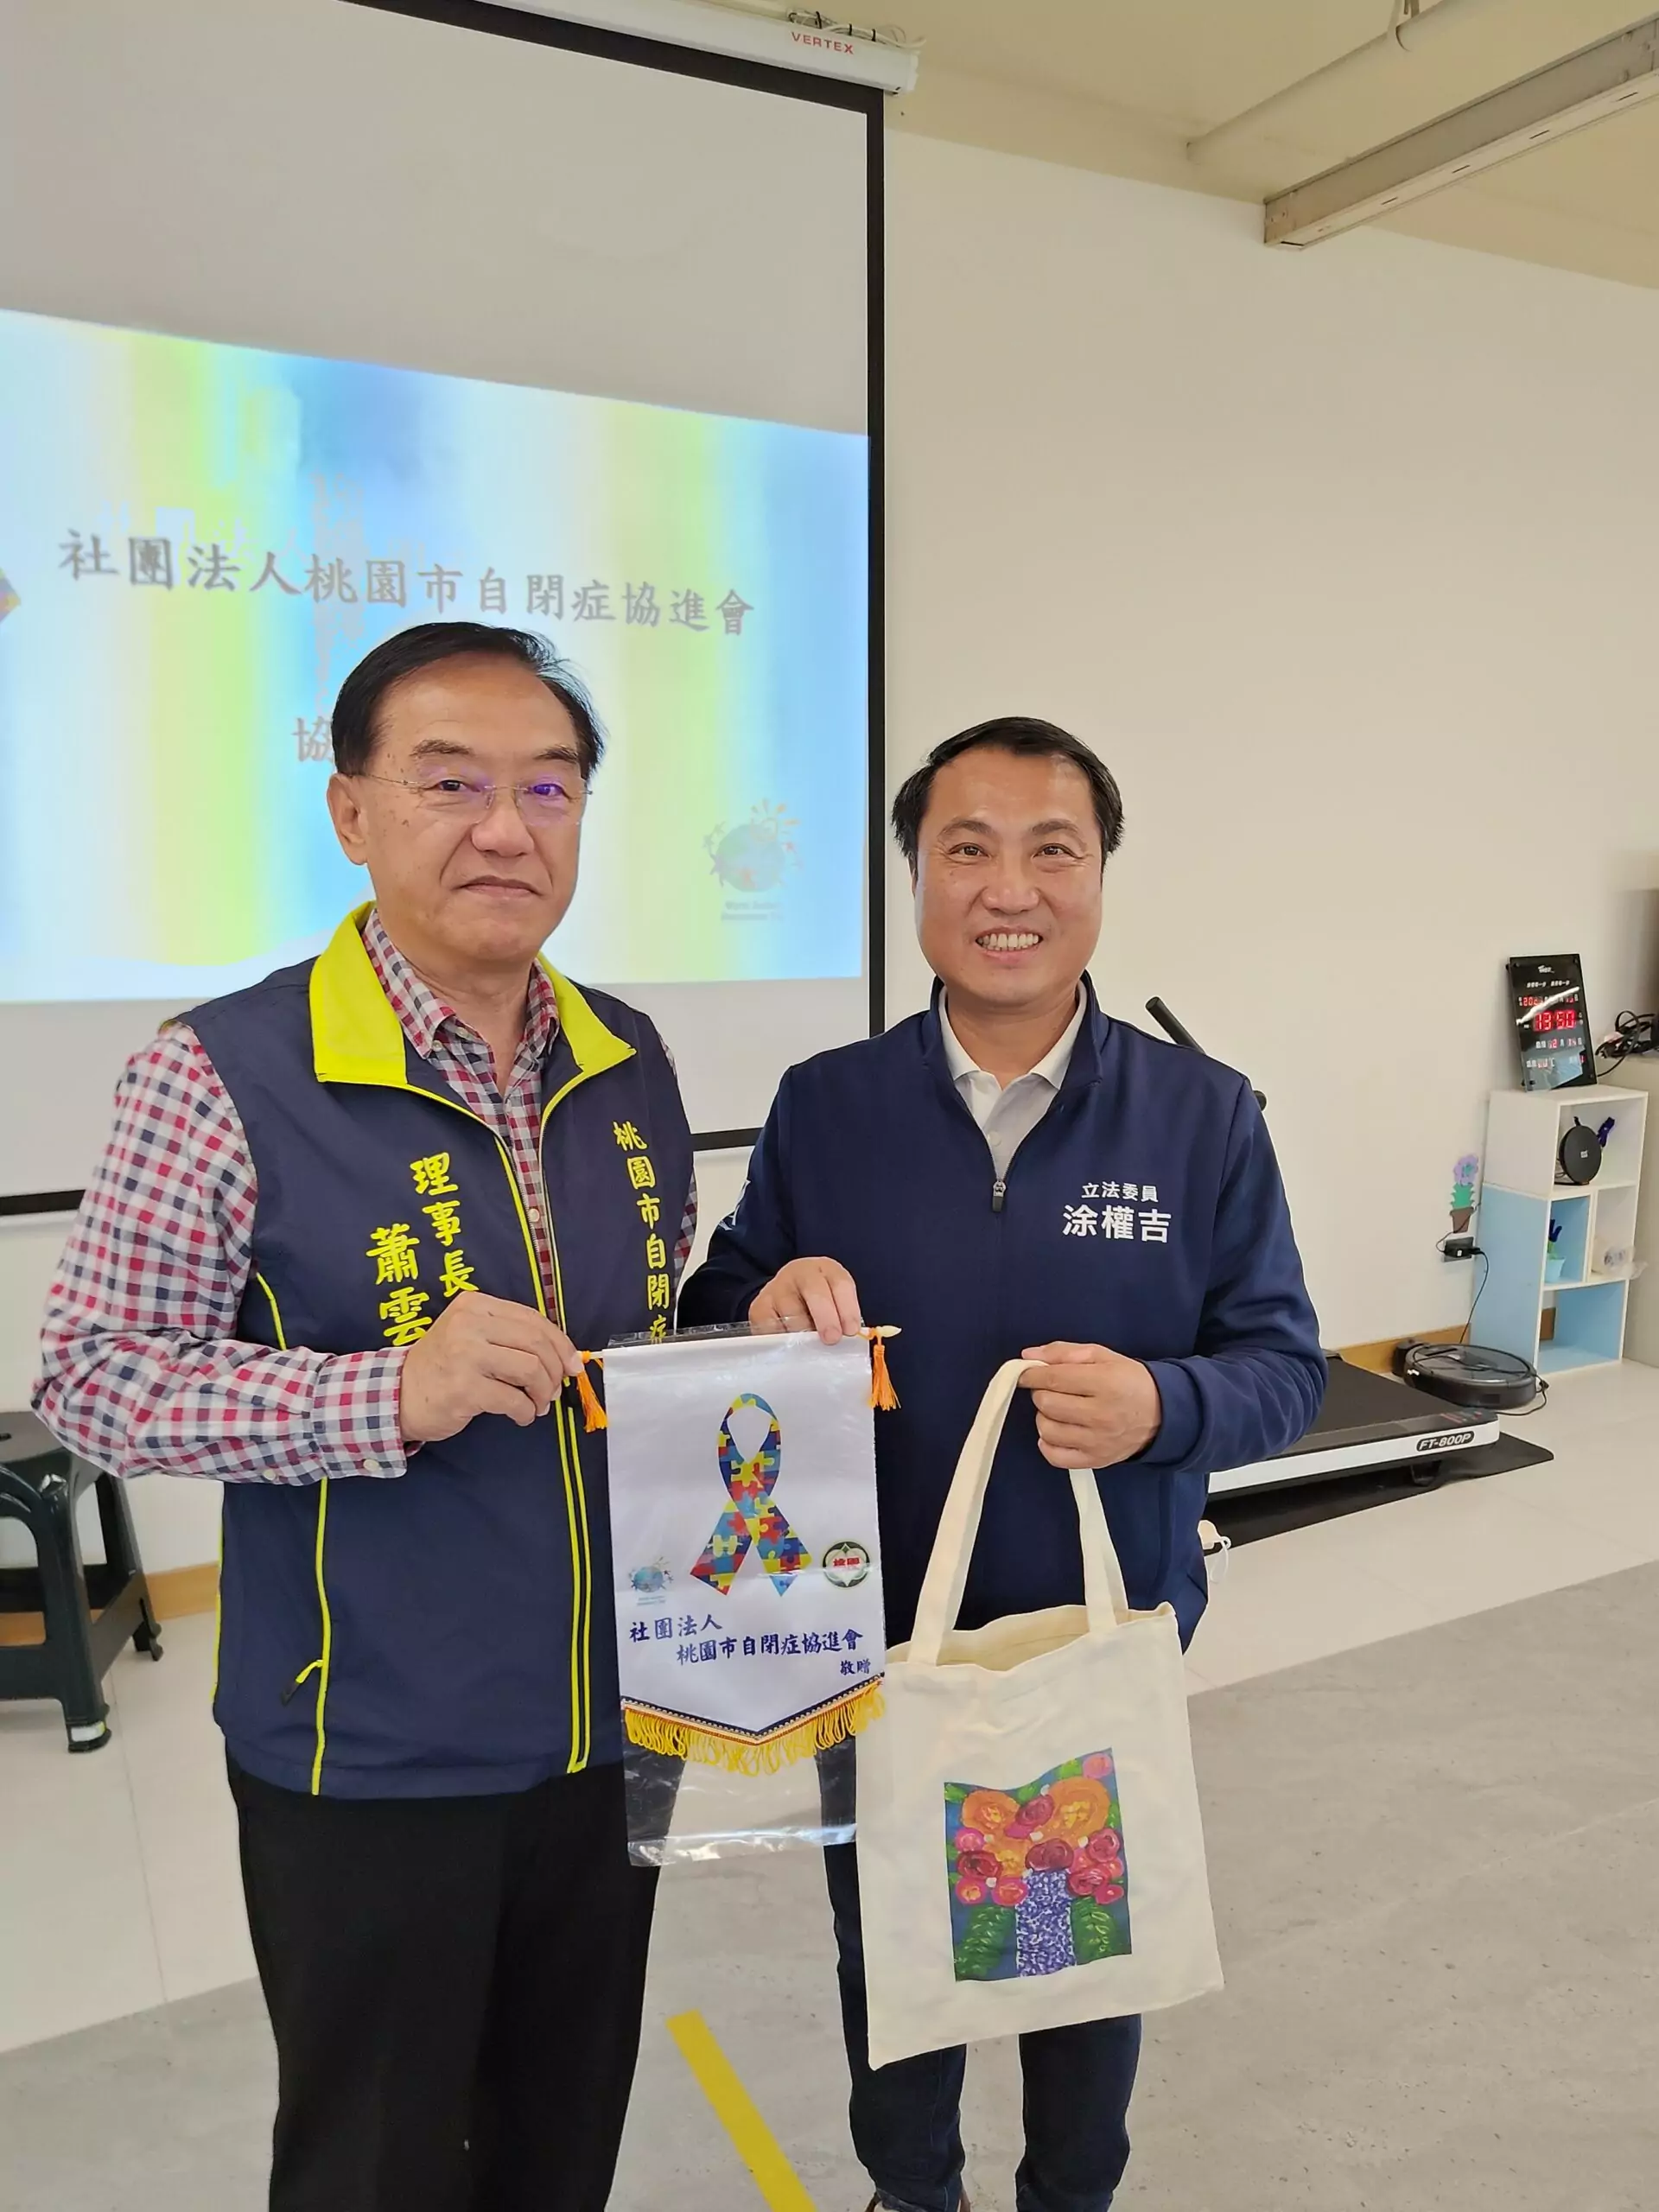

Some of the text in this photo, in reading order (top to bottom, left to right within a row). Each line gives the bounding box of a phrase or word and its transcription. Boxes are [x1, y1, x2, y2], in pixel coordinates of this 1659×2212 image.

[791, 31, 854, 54] VERTEX
[58, 528, 754, 636] 社團法人桃園市自閉症協進會
[1081, 1181, 1159, 1203] 立法委員
[410, 1152, 479, 1298] 理事長
[1062, 1204, 1172, 1243] 涂權吉
[1419, 1433, 1471, 1451] FT-800P
[629, 1614, 722, 1643] 社團法人
[677, 1629, 863, 1666] 桃園市自閉症協進會
